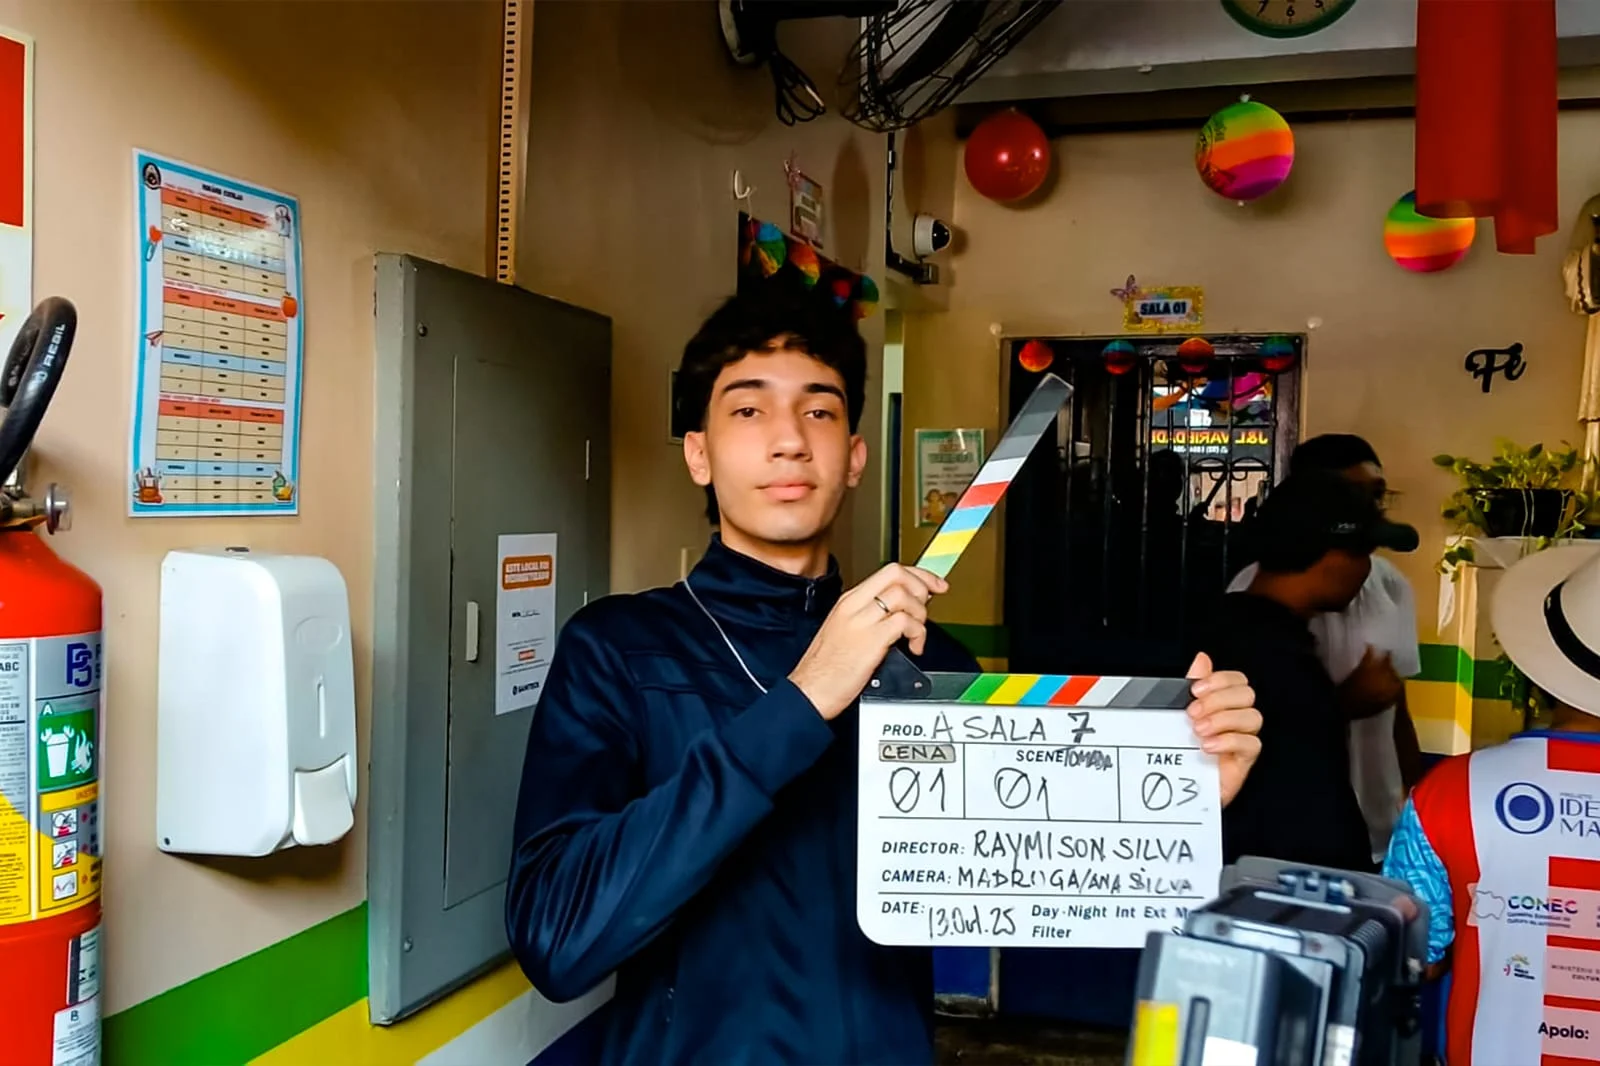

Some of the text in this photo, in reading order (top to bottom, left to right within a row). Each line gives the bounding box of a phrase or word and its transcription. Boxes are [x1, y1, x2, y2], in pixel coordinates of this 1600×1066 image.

[1286, 5, 1295, 17] 6
[1140, 302, 1171, 316] SALA
[43, 704, 53, 716] A
[882, 711, 1096, 744] PROD. A SALA 7
[882, 745, 947, 761] CENA
[1016, 750, 1064, 763] SCENE
[1147, 753, 1183, 766] TAKE
[881, 841, 965, 855] DIRECTOR:
[1112, 838, 1193, 864] SILVA
[881, 869, 951, 884] CAMERA:
[881, 901, 925, 914] DATE:
[1508, 895, 1578, 914] CONEC
[1115, 906, 1136, 919] Int
[1144, 906, 1166, 919] Ext
[1031, 925, 1072, 939] Filter
